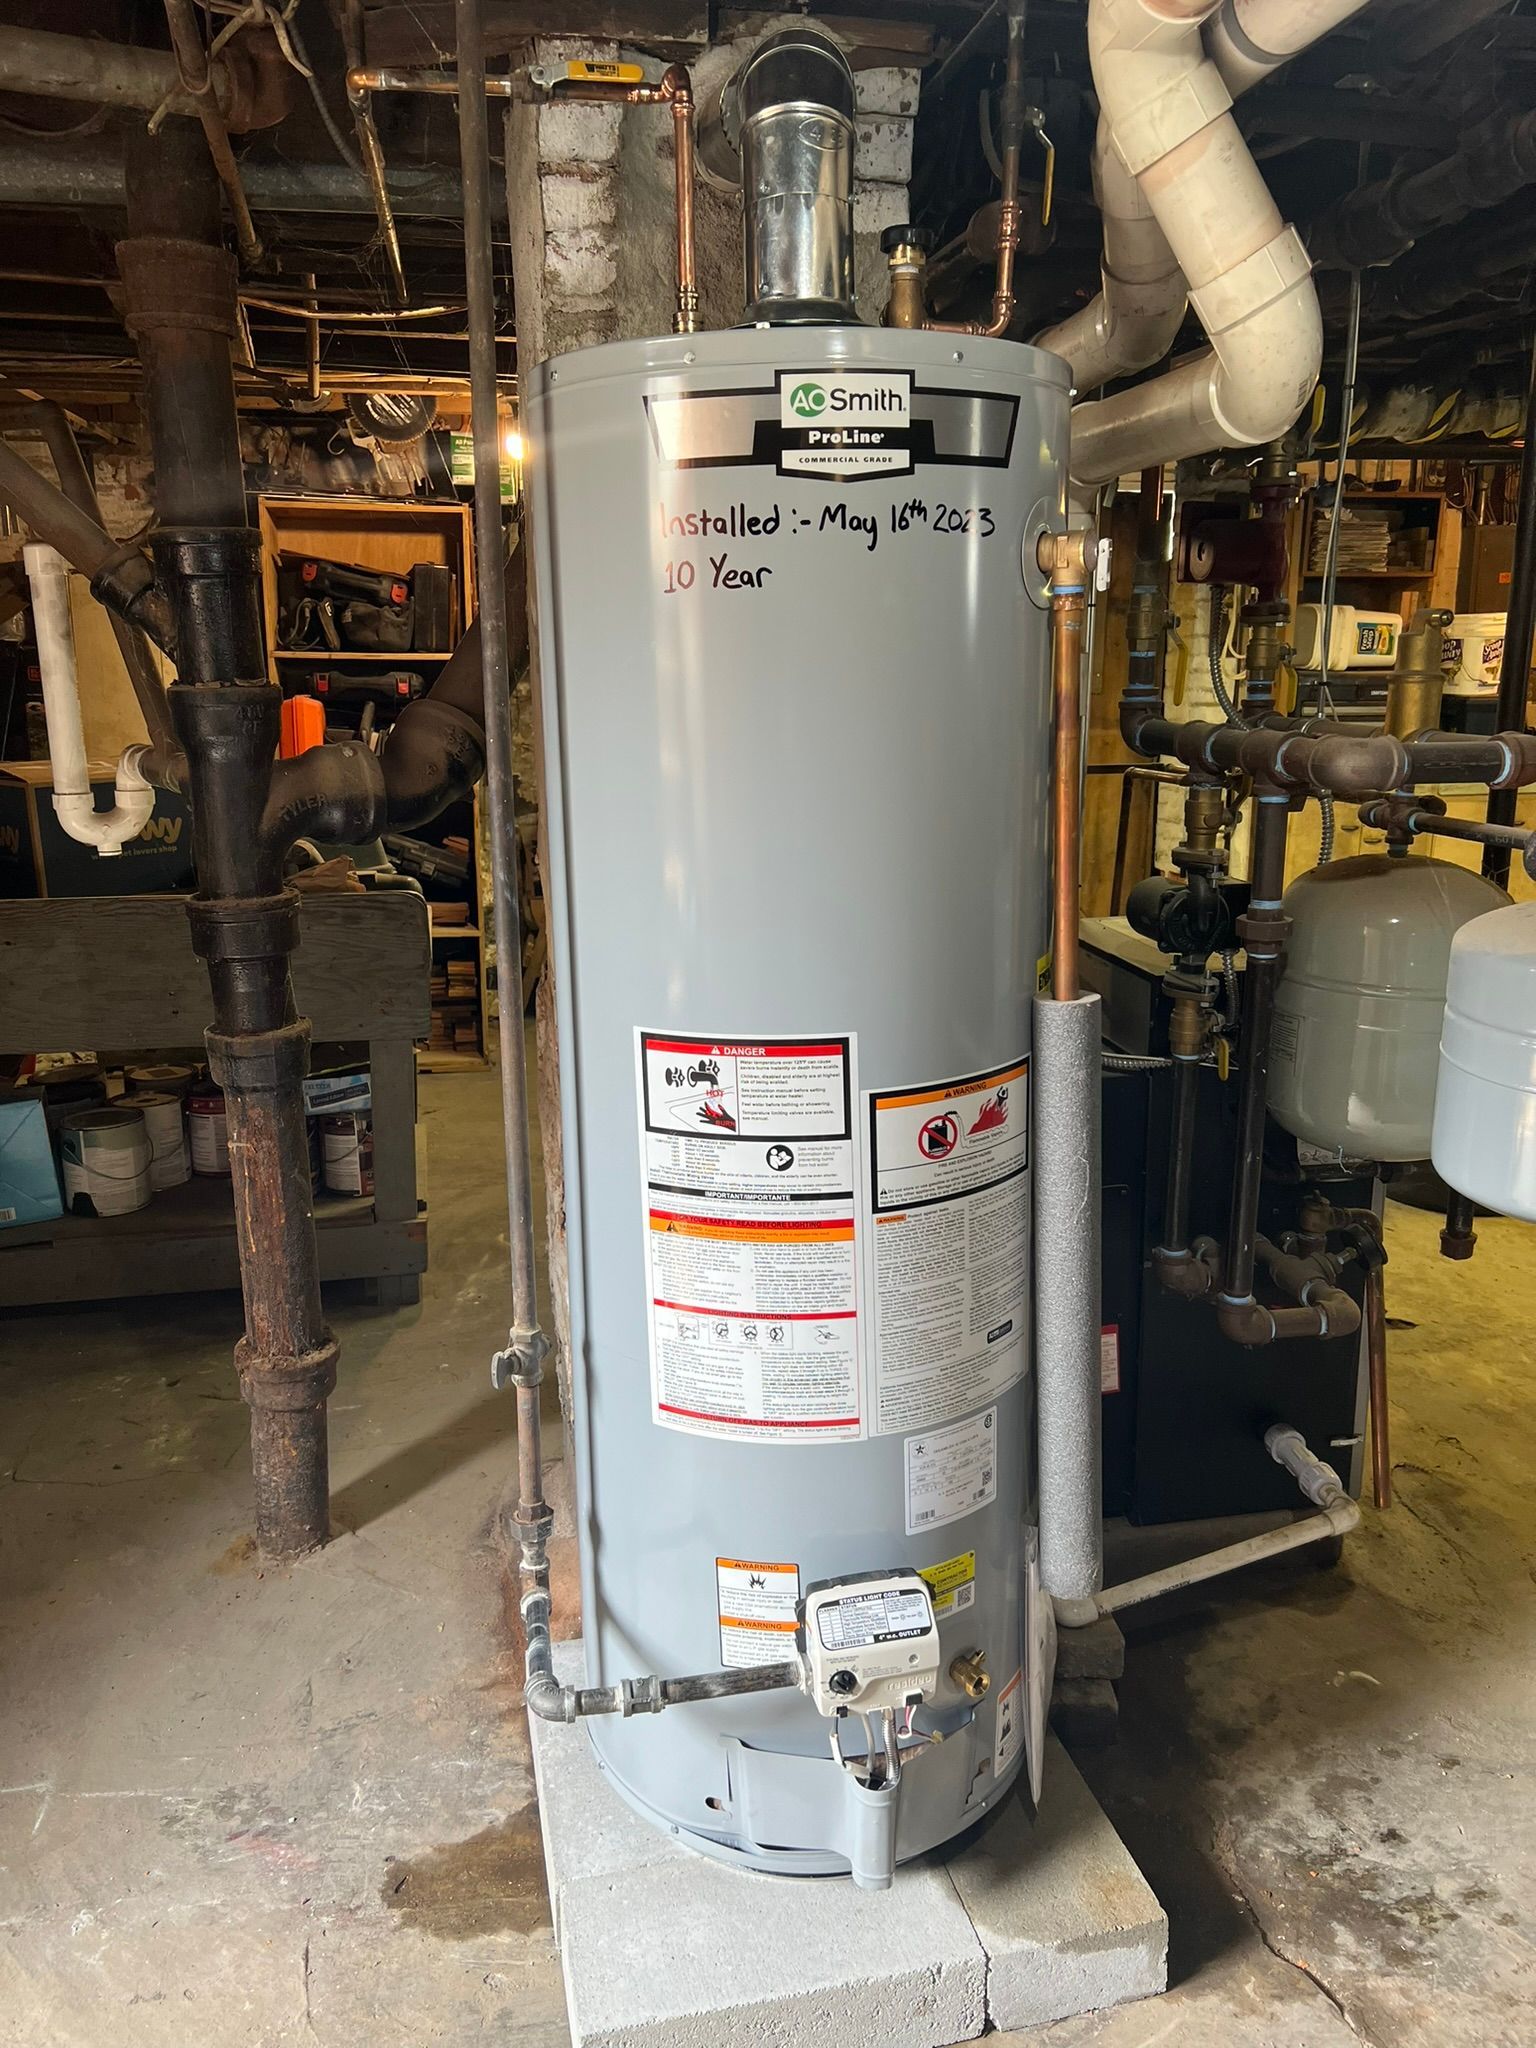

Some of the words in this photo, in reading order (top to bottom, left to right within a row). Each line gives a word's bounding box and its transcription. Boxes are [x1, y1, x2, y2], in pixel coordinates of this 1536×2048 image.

[790, 383, 827, 417] AO
[830, 388, 903, 411] Smith
[808, 429, 881, 444] ProLine
[660, 502, 780, 538] Installed
[819, 503, 878, 551] May
[933, 504, 996, 537] 2023
[664, 560, 696, 593] 10
[709, 553, 773, 589] Year
[724, 1047, 766, 1056] DANGER
[706, 1090, 724, 1098] HOT
[953, 1082, 986, 1096] WARNING
[704, 1191, 791, 1201] IMPORTANT/IMPORTANTE
[710, 1218, 736, 1226] SAFETY
[742, 1562, 780, 1571] WARNING
[839, 1596, 862, 1604] STATUS
[745, 1620, 782, 1630] WARNING
